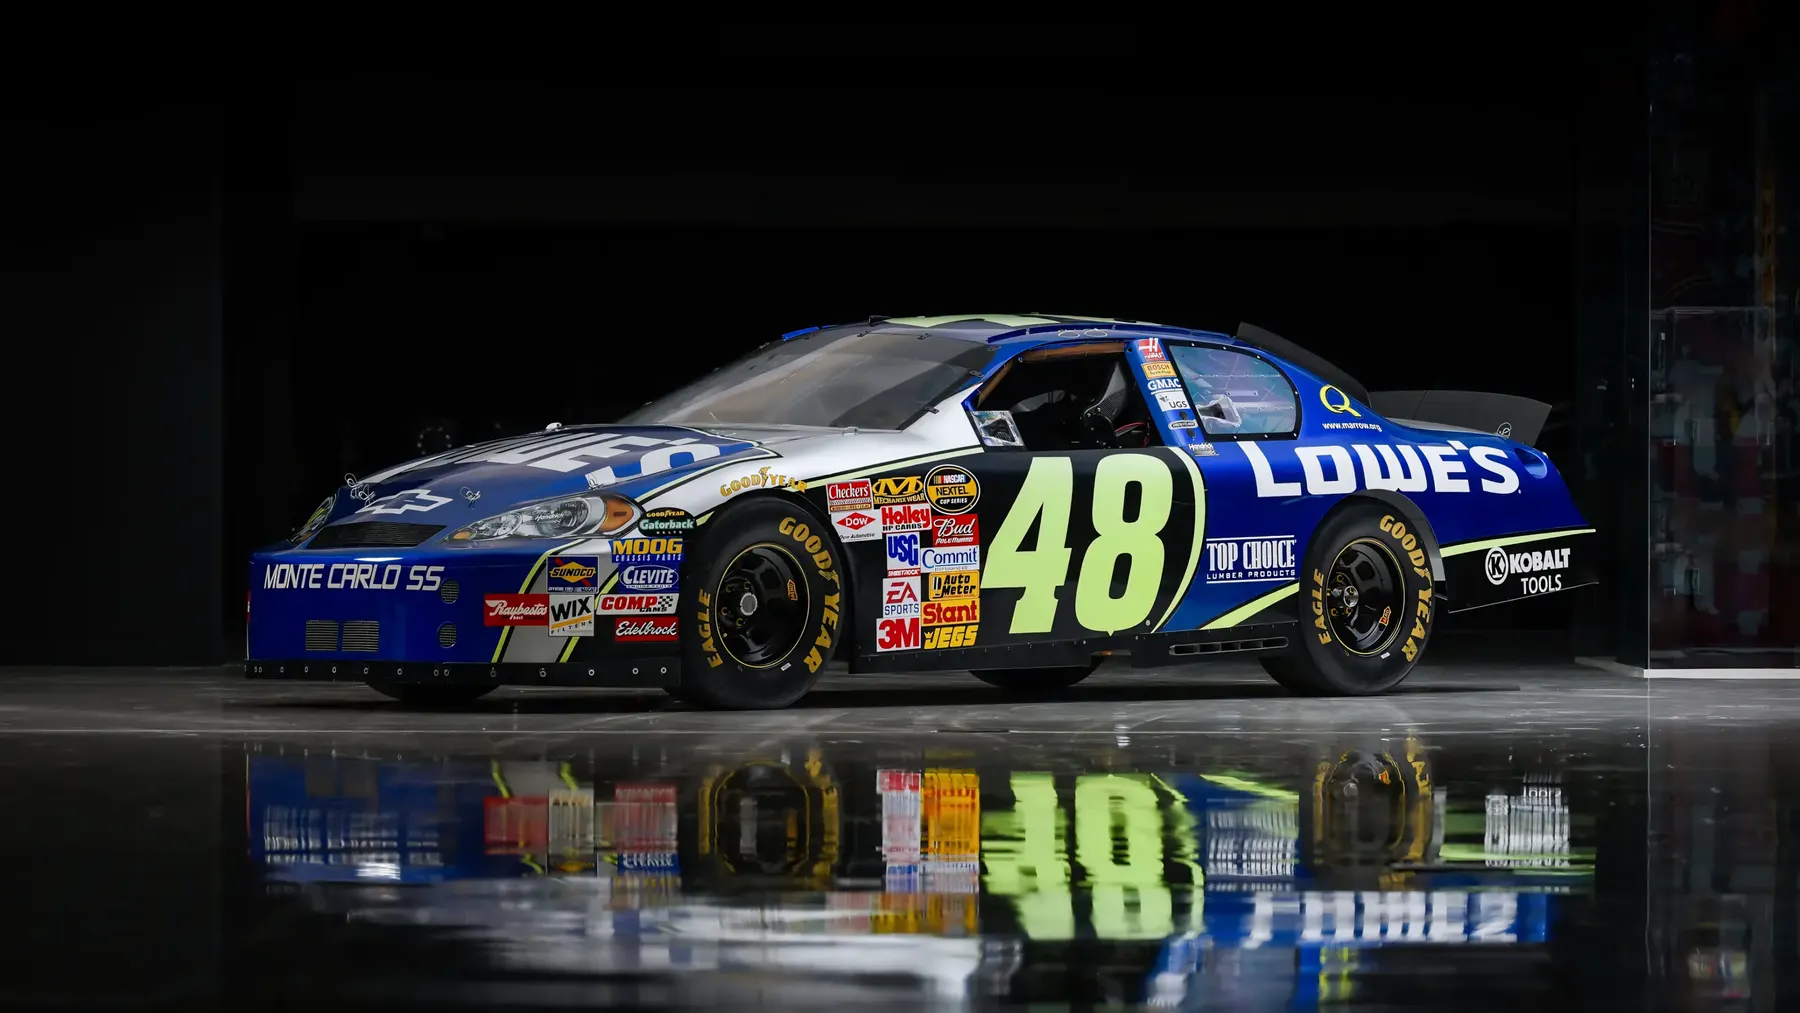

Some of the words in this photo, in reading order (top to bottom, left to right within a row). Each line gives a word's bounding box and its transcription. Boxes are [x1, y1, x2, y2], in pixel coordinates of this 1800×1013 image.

[1147, 379, 1181, 391] GMAC
[1169, 400, 1188, 409] UGS
[1319, 384, 1362, 417] Q
[1321, 423, 1383, 432] www.marrow.org
[1235, 439, 1520, 498] LOWE'S
[943, 474, 967, 484] NASCAR
[829, 483, 869, 499] Checkers
[874, 495, 907, 504] MECHANIX
[907, 493, 925, 502] WEAR
[936, 485, 969, 496] NEXTEL
[640, 519, 695, 530] Gatorback
[845, 517, 869, 527] DOW
[881, 505, 931, 528] Holley
[933, 517, 976, 537] Bud
[612, 538, 684, 555] MOOG
[887, 534, 919, 566] USG
[980, 453, 1173, 636] 48
[615, 554, 651, 562] CHASSIS
[922, 547, 978, 569] Commit
[1206, 542, 1239, 571] TOP
[1242, 540, 1296, 570] CHOICE
[1509, 547, 1571, 574] KOBALT
[263, 563, 325, 589] MONTE
[327, 563, 402, 590] CARLO
[406, 565, 445, 591] SS
[551, 568, 594, 577] SUNOCO
[622, 565, 675, 585] CLEVITE
[943, 574, 970, 585] Auto
[1206, 571, 1243, 580] LUMBER
[1247, 569, 1296, 578] PRODUCTS
[885, 581, 918, 604] EA
[941, 584, 977, 595] Meter
[1520, 574, 1562, 595] TOOLS
[485, 599, 548, 620] Raybestos
[550, 596, 592, 622] WIX
[601, 596, 658, 611] COMP
[884, 603, 920, 616] SPORTS
[922, 600, 977, 624] Stant
[1311, 568, 1333, 645] EAGLE
[551, 620, 593, 634] FILTERS
[616, 620, 677, 636] Edelbrock
[697, 588, 724, 669] EAGLE
[877, 617, 920, 649] 3M
[924, 624, 979, 650] JEGS
